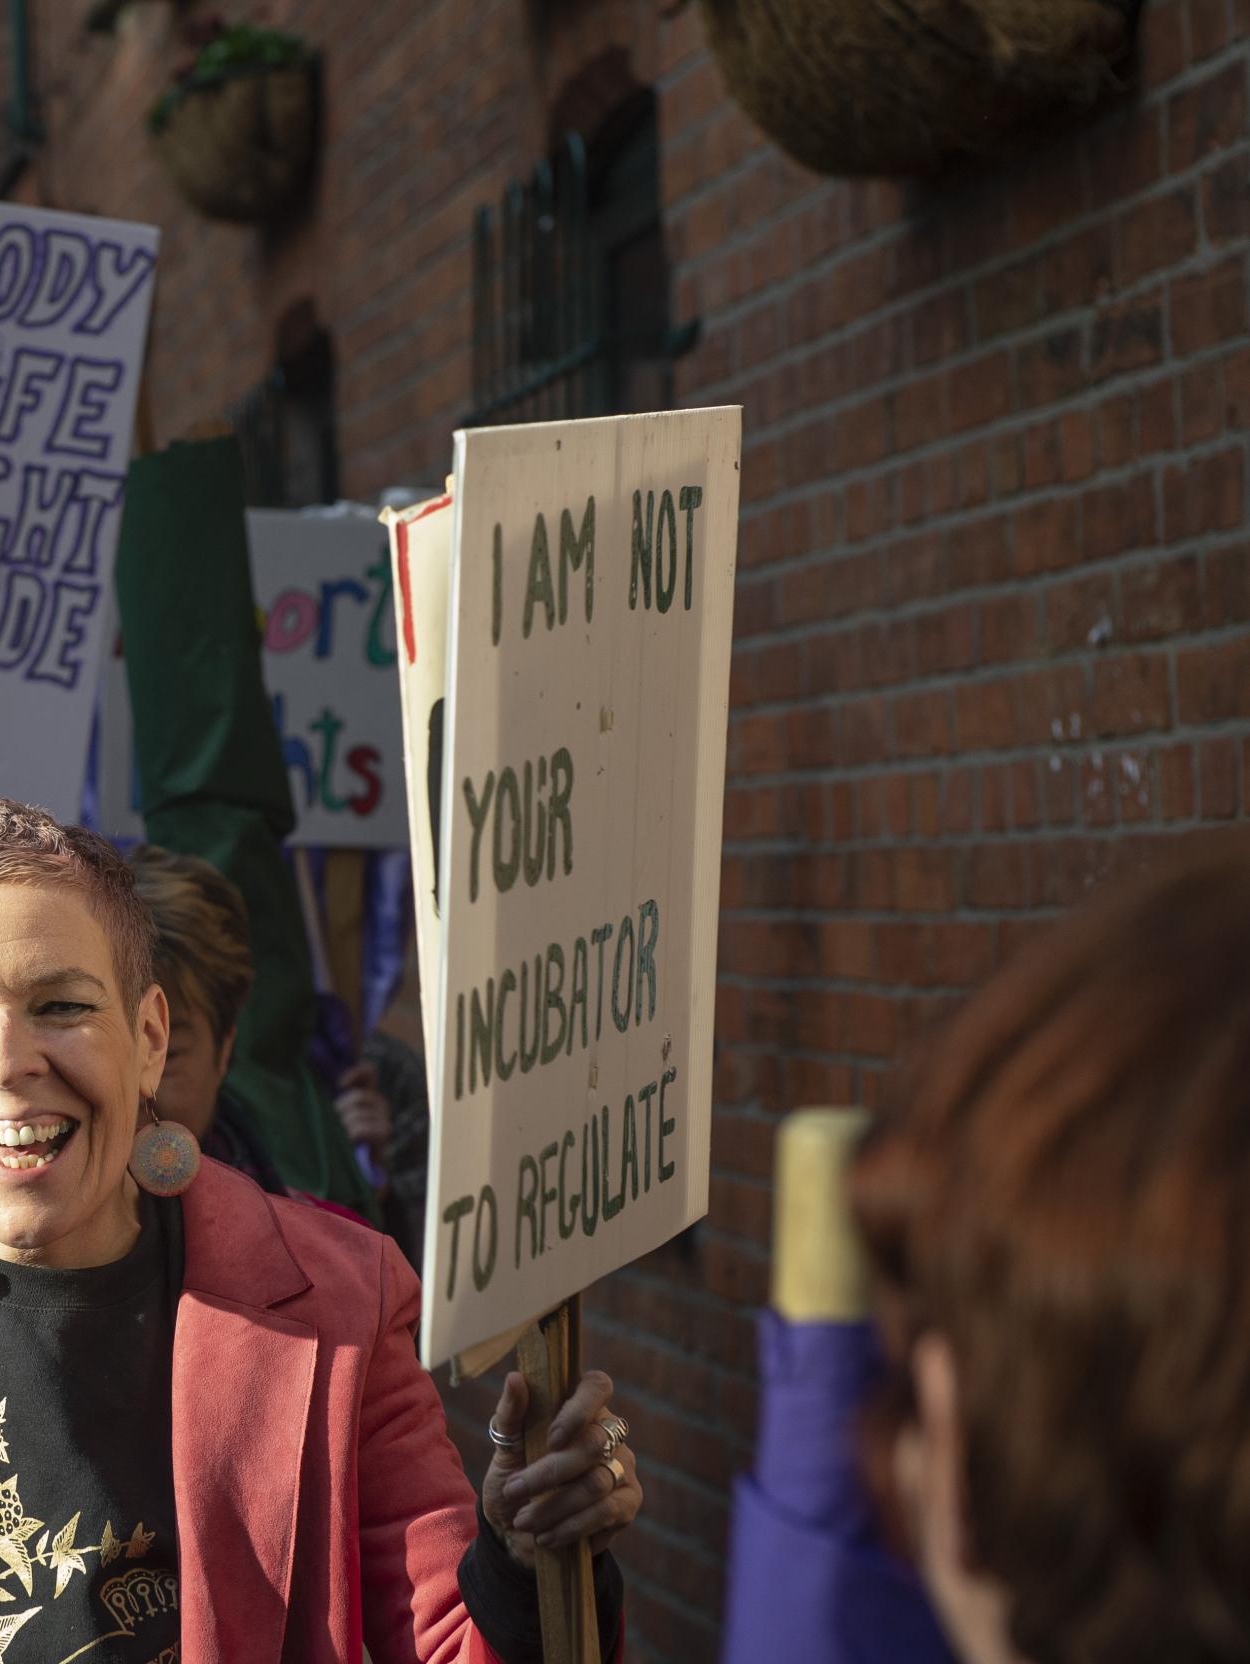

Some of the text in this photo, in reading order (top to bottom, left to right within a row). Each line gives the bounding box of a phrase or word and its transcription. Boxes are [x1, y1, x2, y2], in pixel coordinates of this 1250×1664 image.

[255, 542, 396, 668] ort
[492, 486, 703, 647] I AM NOT
[463, 747, 574, 903] YOUR
[455, 899, 660, 1101] INCUBATOR
[442, 1184, 498, 1301] TO
